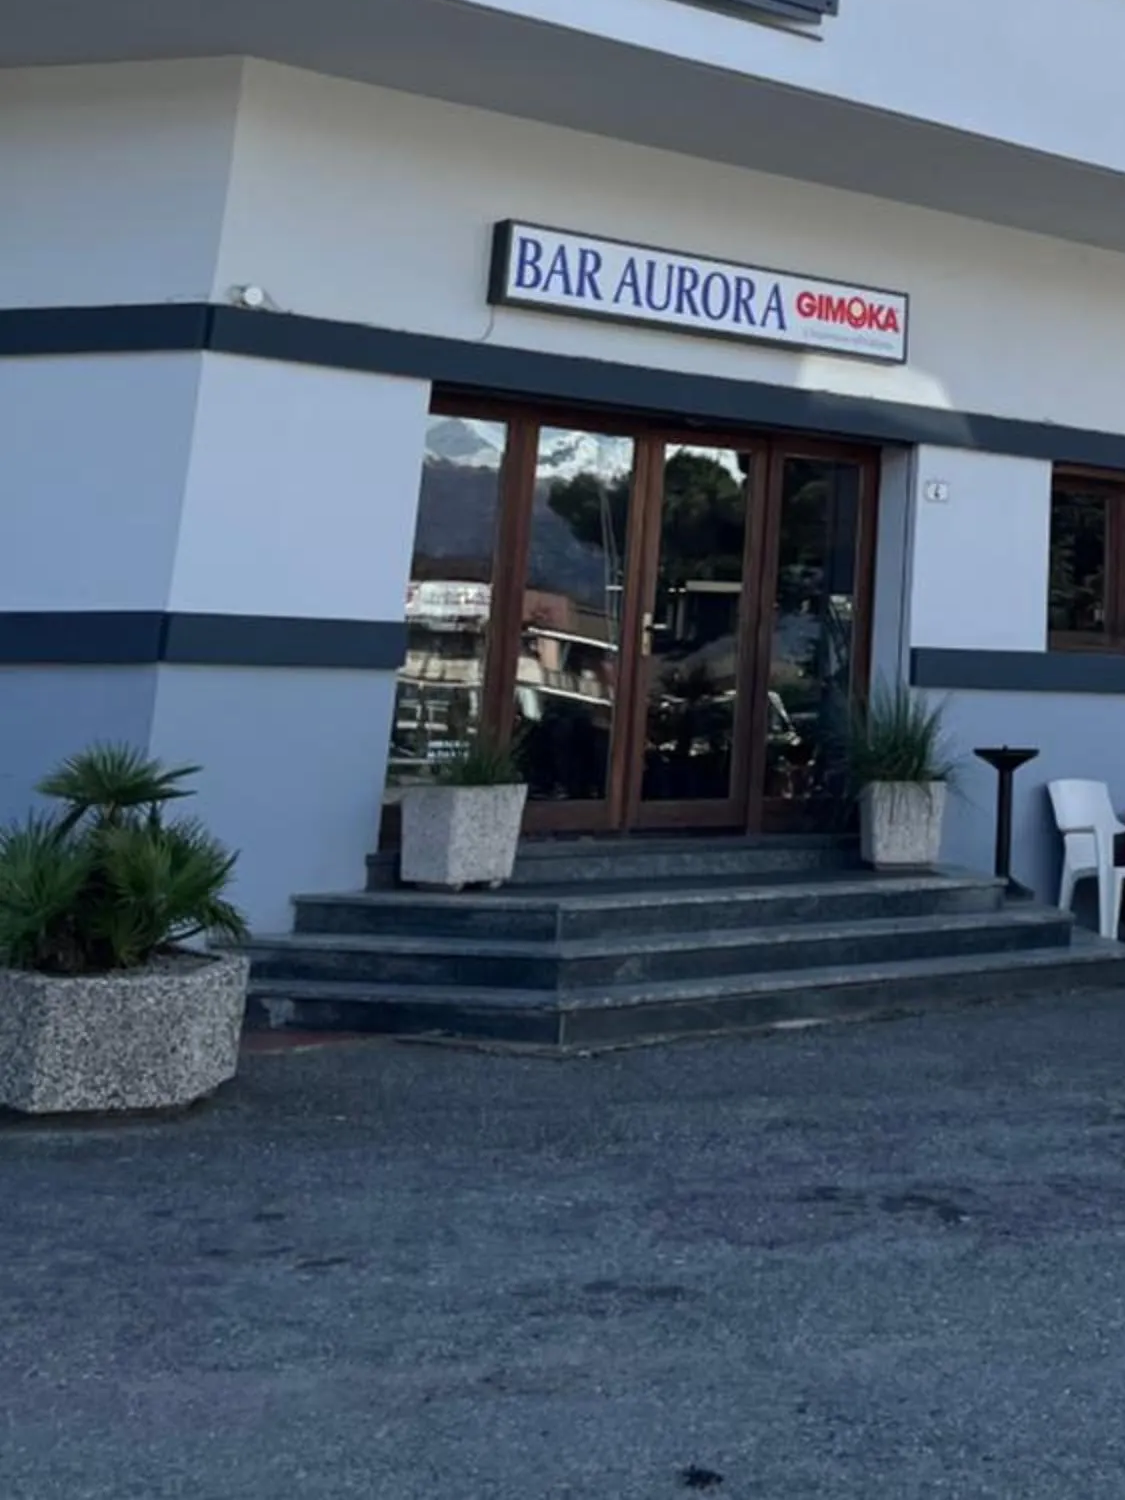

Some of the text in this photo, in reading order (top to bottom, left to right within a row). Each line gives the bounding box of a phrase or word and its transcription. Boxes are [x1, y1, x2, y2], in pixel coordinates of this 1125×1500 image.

[515, 236, 787, 331] BAR AURORA
[796, 291, 900, 333] GIMOKA
